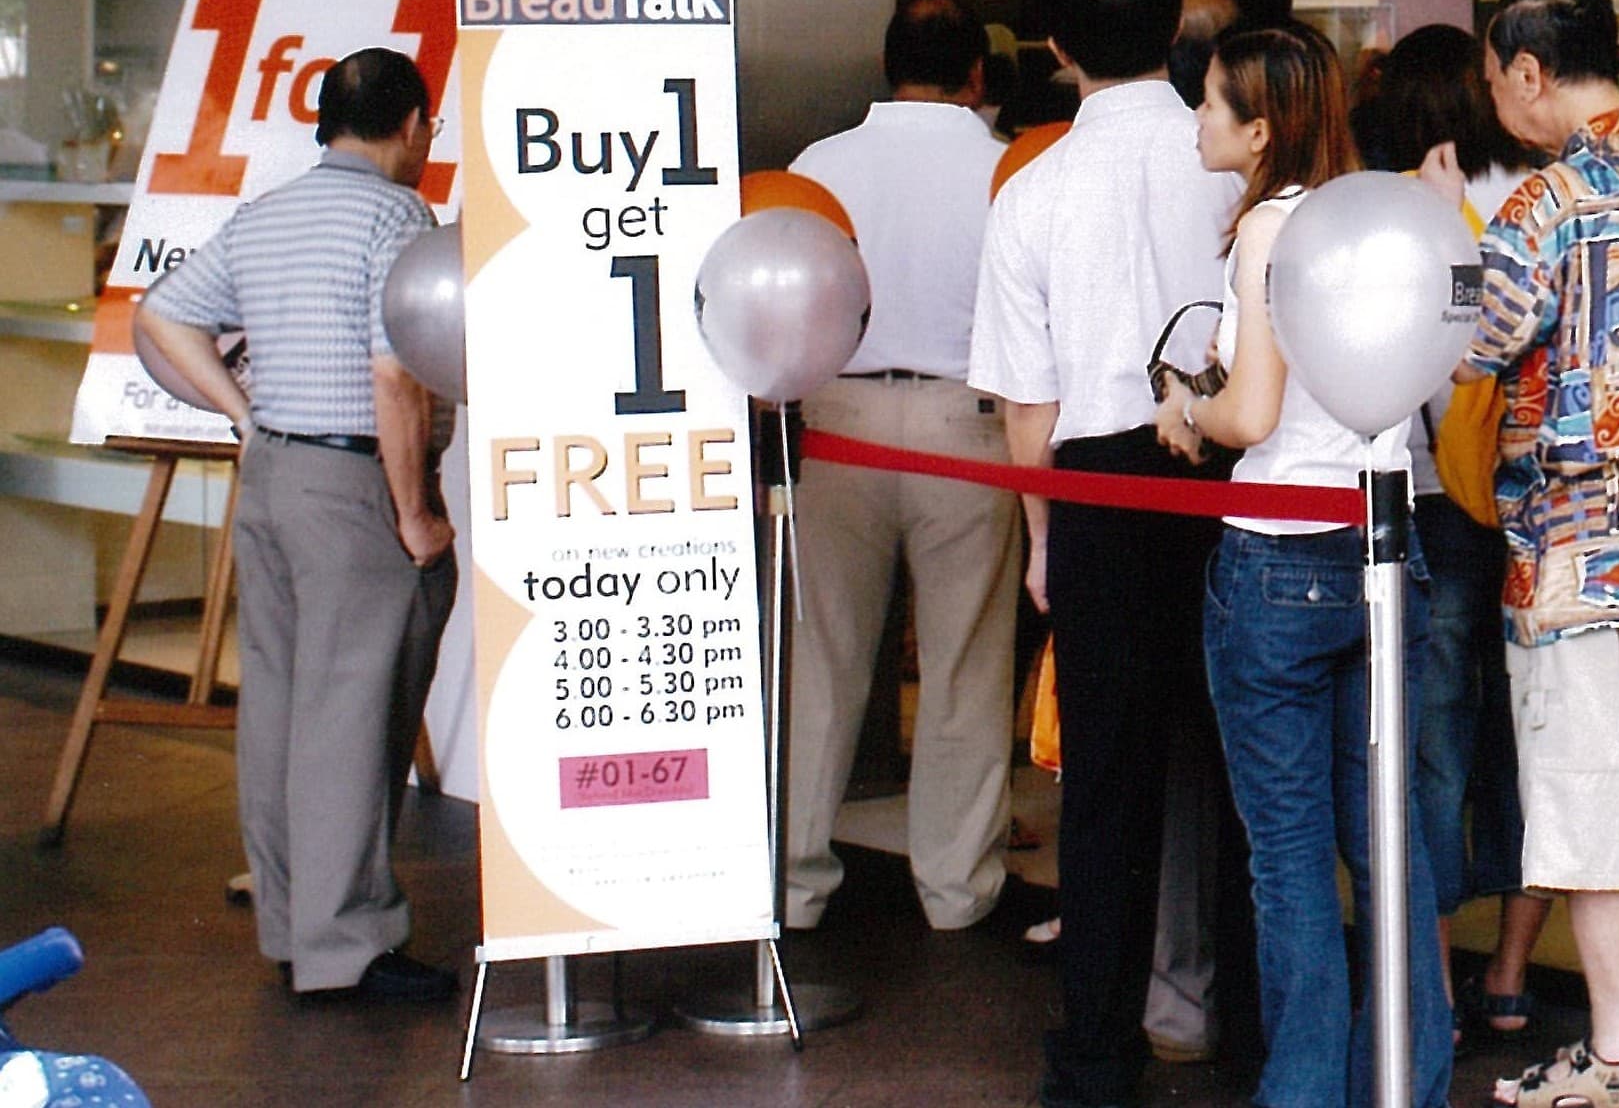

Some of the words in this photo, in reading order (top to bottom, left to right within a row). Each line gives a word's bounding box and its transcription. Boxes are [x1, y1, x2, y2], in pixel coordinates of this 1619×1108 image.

[249, 34, 330, 123] fo
[515, 107, 660, 192] Buy
[661, 77, 718, 186] 1
[582, 196, 669, 251] get
[133, 237, 198, 273] Ne
[609, 254, 687, 416] 1
[489, 427, 739, 522] FREE
[551, 548, 580, 562] on
[587, 546, 629, 560] new
[638, 538, 737, 559] creations
[523, 562, 641, 606] today
[657, 556, 740, 601] only
[553, 617, 611, 643] 3.00
[637, 613, 693, 639] 3.30
[702, 617, 741, 639] pm
[553, 646, 612, 671] 4.00
[638, 642, 694, 667] 4.30
[704, 646, 742, 668] pm
[555, 675, 612, 700] 5.00
[640, 670, 695, 696] 5.30
[705, 674, 743, 697] pm
[555, 703, 613, 730] 6.00
[640, 699, 696, 725] 6.30
[706, 703, 745, 726] pm
[575, 756, 689, 790] #01-67
